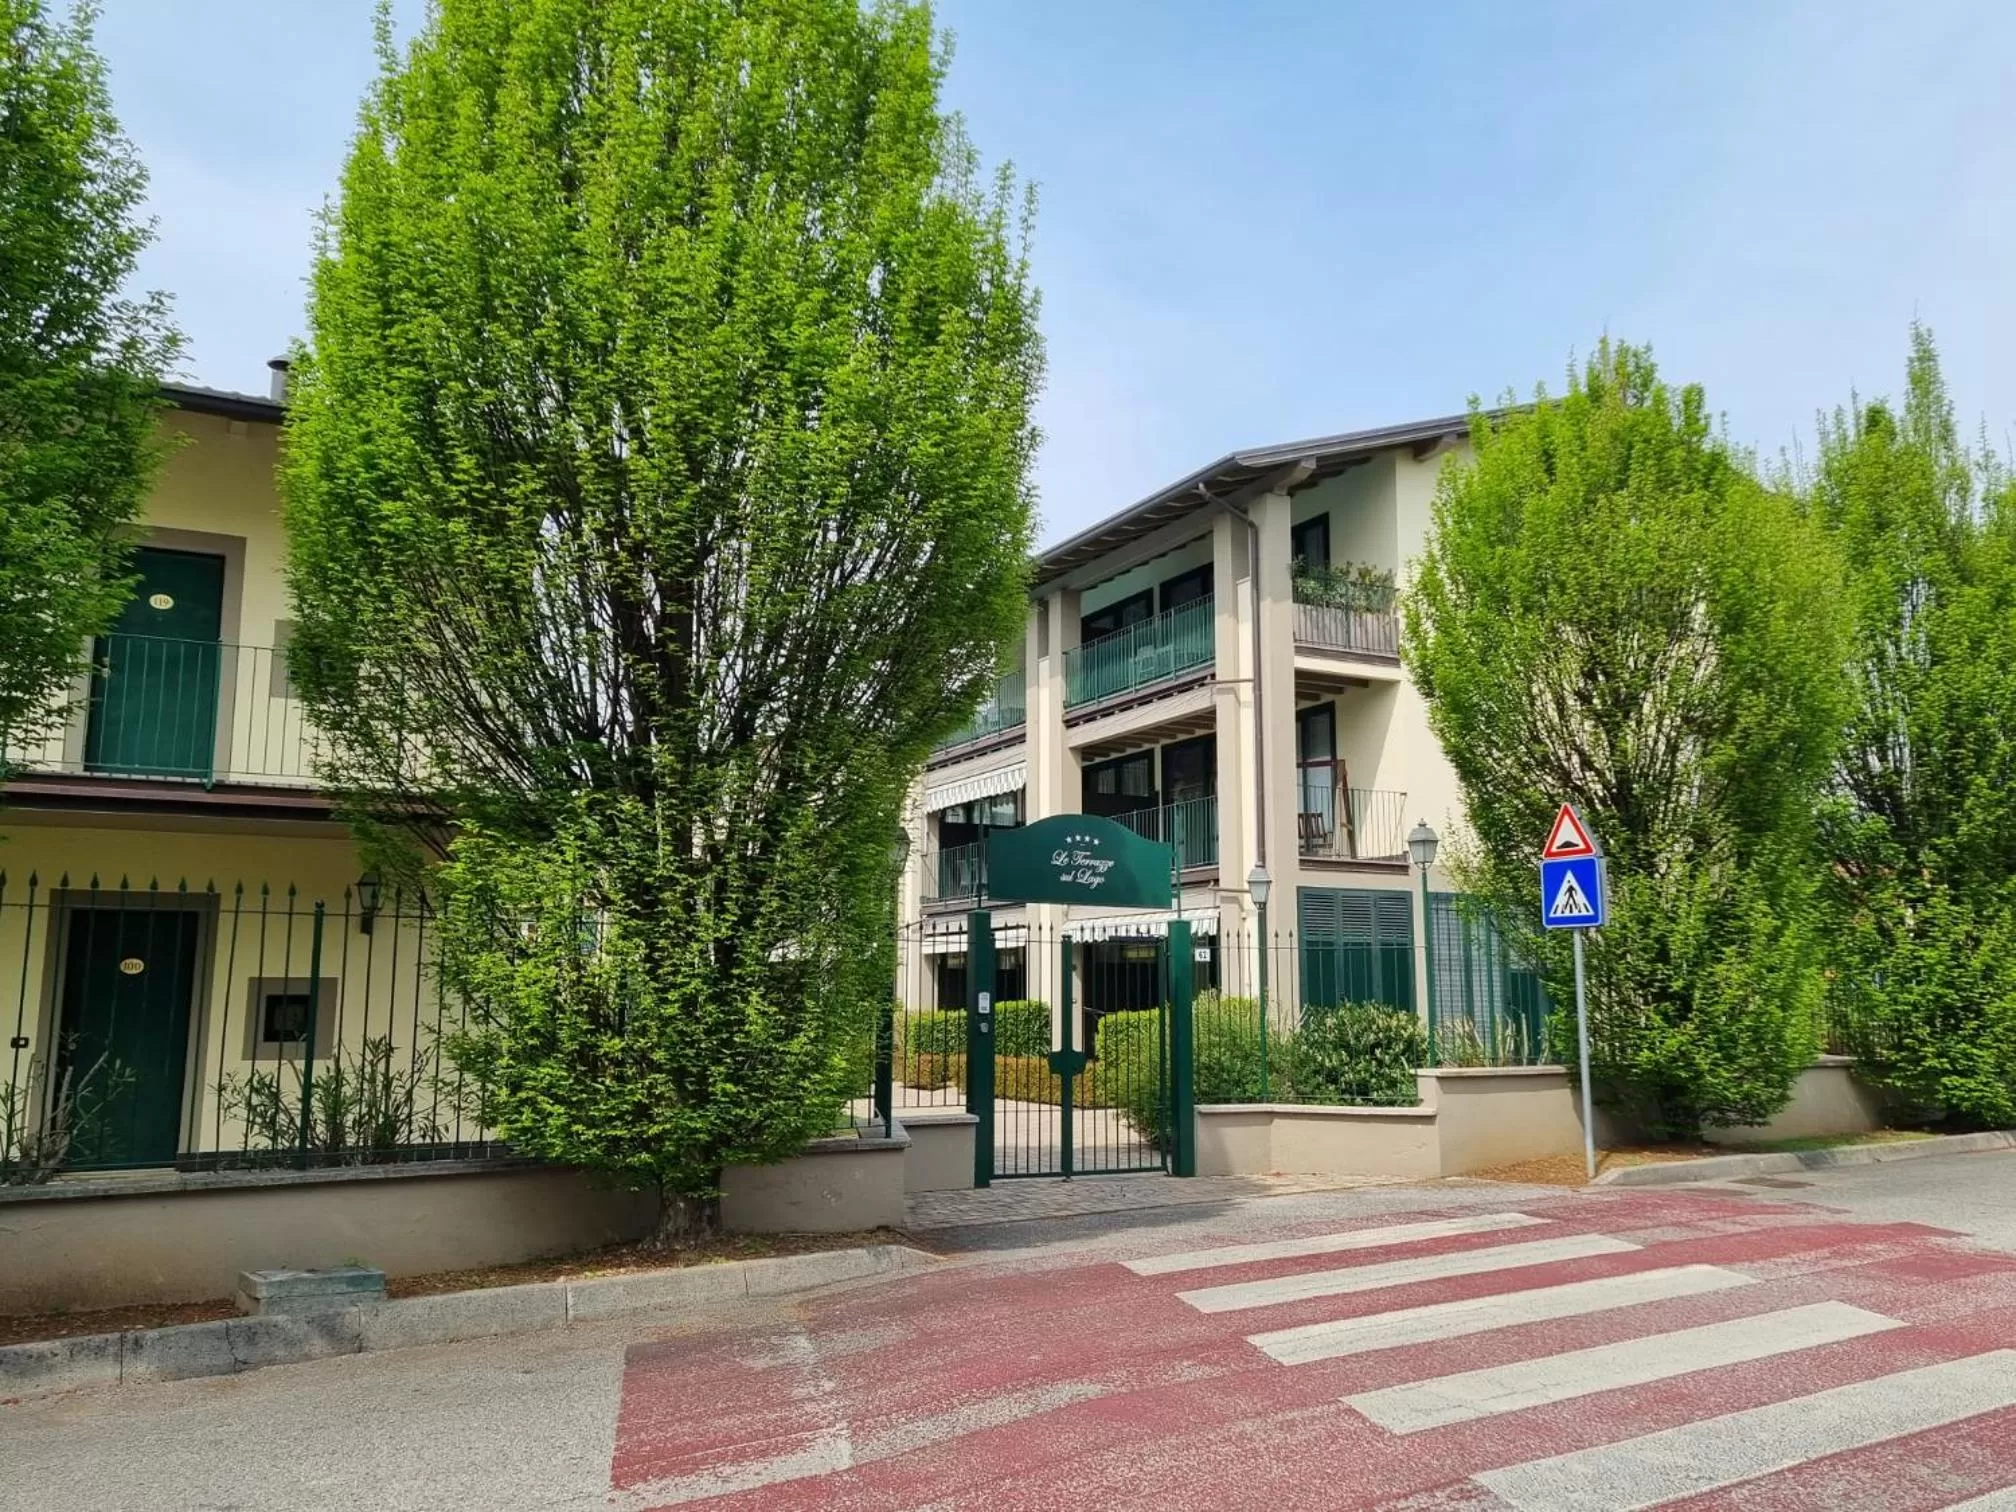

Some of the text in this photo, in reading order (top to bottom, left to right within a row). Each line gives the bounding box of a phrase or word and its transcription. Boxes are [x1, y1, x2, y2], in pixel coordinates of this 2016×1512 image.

[1050, 849, 1115, 873] Le Terrazze
[1060, 867, 1105, 890] sul Lago
